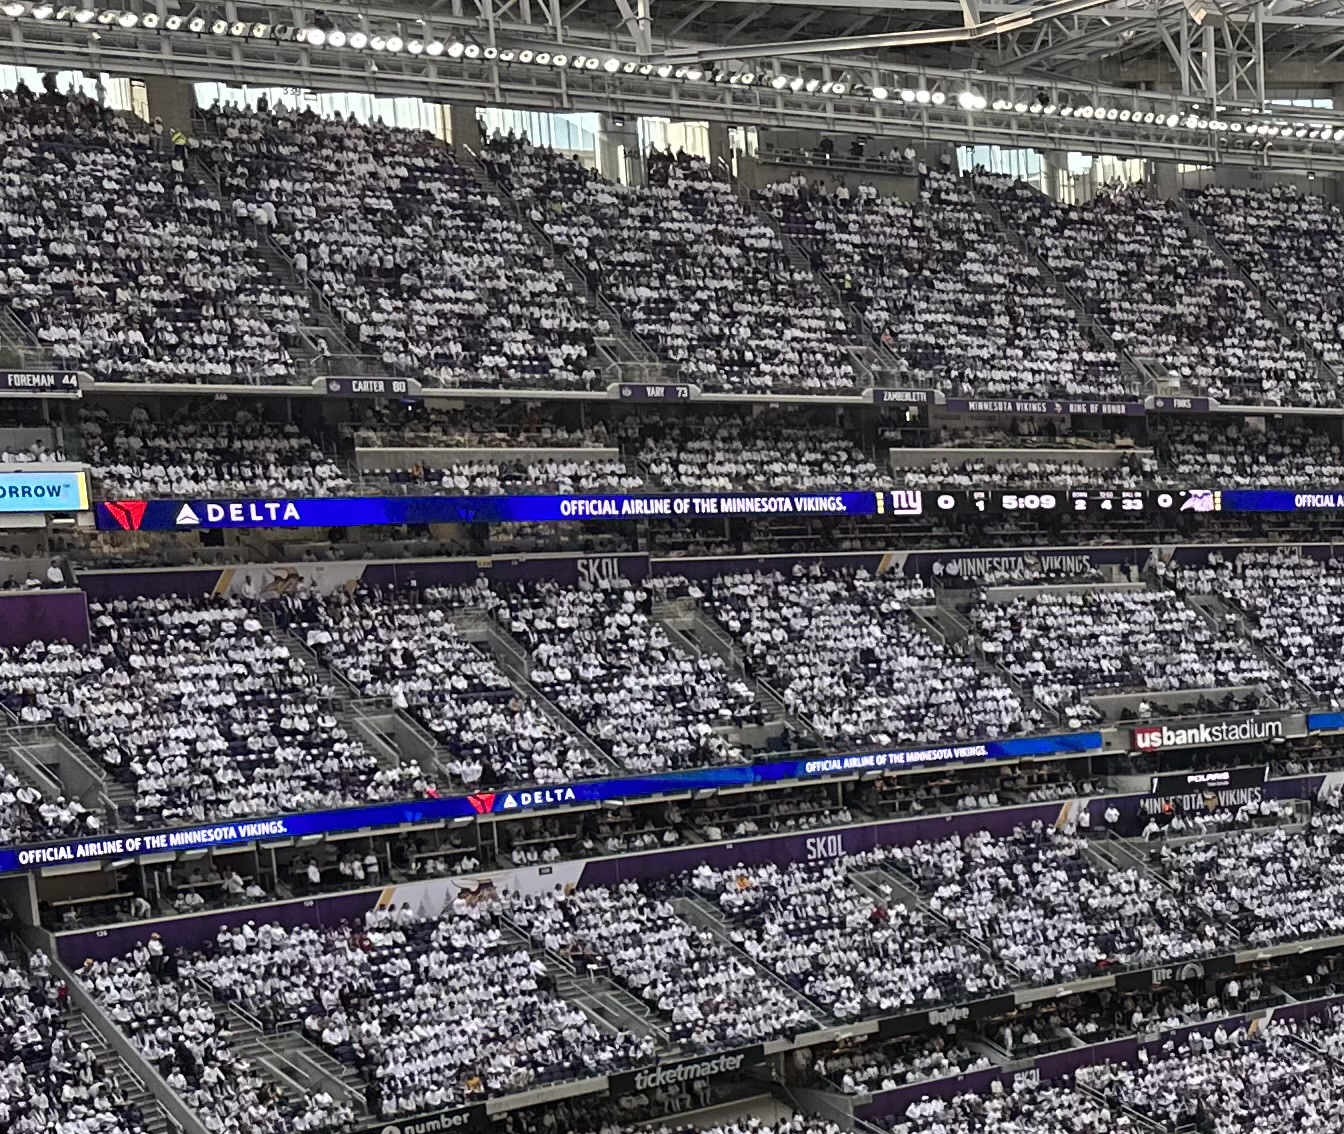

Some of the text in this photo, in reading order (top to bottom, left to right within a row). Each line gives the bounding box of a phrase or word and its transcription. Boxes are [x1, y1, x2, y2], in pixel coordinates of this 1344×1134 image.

[8, 374, 78, 388] FOREMAN 44
[352, 380, 385, 393] CARTER
[676, 386, 689, 398] 73
[968, 401, 1047, 413] MINNESOTA VIKINGS
[560, 496, 848, 516] OFFICIAL AIRLINE OF THE MINNESOTA VIKINGS.
[937, 495, 955, 510] 0
[975, 500, 985, 511] 1
[1002, 494, 1056, 509] 5:09
[1074, 500, 1087, 510] 2
[1100, 500, 1113, 510] 4
[1122, 499, 1143, 510] 33
[1158, 493, 1172, 508] 0
[1294, 494, 1336, 508] OFFICIAL
[207, 501, 301, 523] DELTA
[1040, 555, 1091, 574] VIKINGS
[806, 758, 843, 774] OFFICIAL
[844, 755, 875, 769] AIRLINE
[875, 753, 888, 766] OF
[889, 752, 905, 765] THE
[906, 748, 953, 764] MINNESOTA
[1187, 771, 1230, 784] POLARIS
[520, 787, 577, 805] DELTA
[1218, 786, 1262, 808] VIKINGS
[19, 820, 288, 865] OFFICIAL AIRLINE OF THE MINNESOTA VIKINGS.
[806, 834, 847, 860] SKOL
[634, 1053, 745, 1091] ticketmaster
